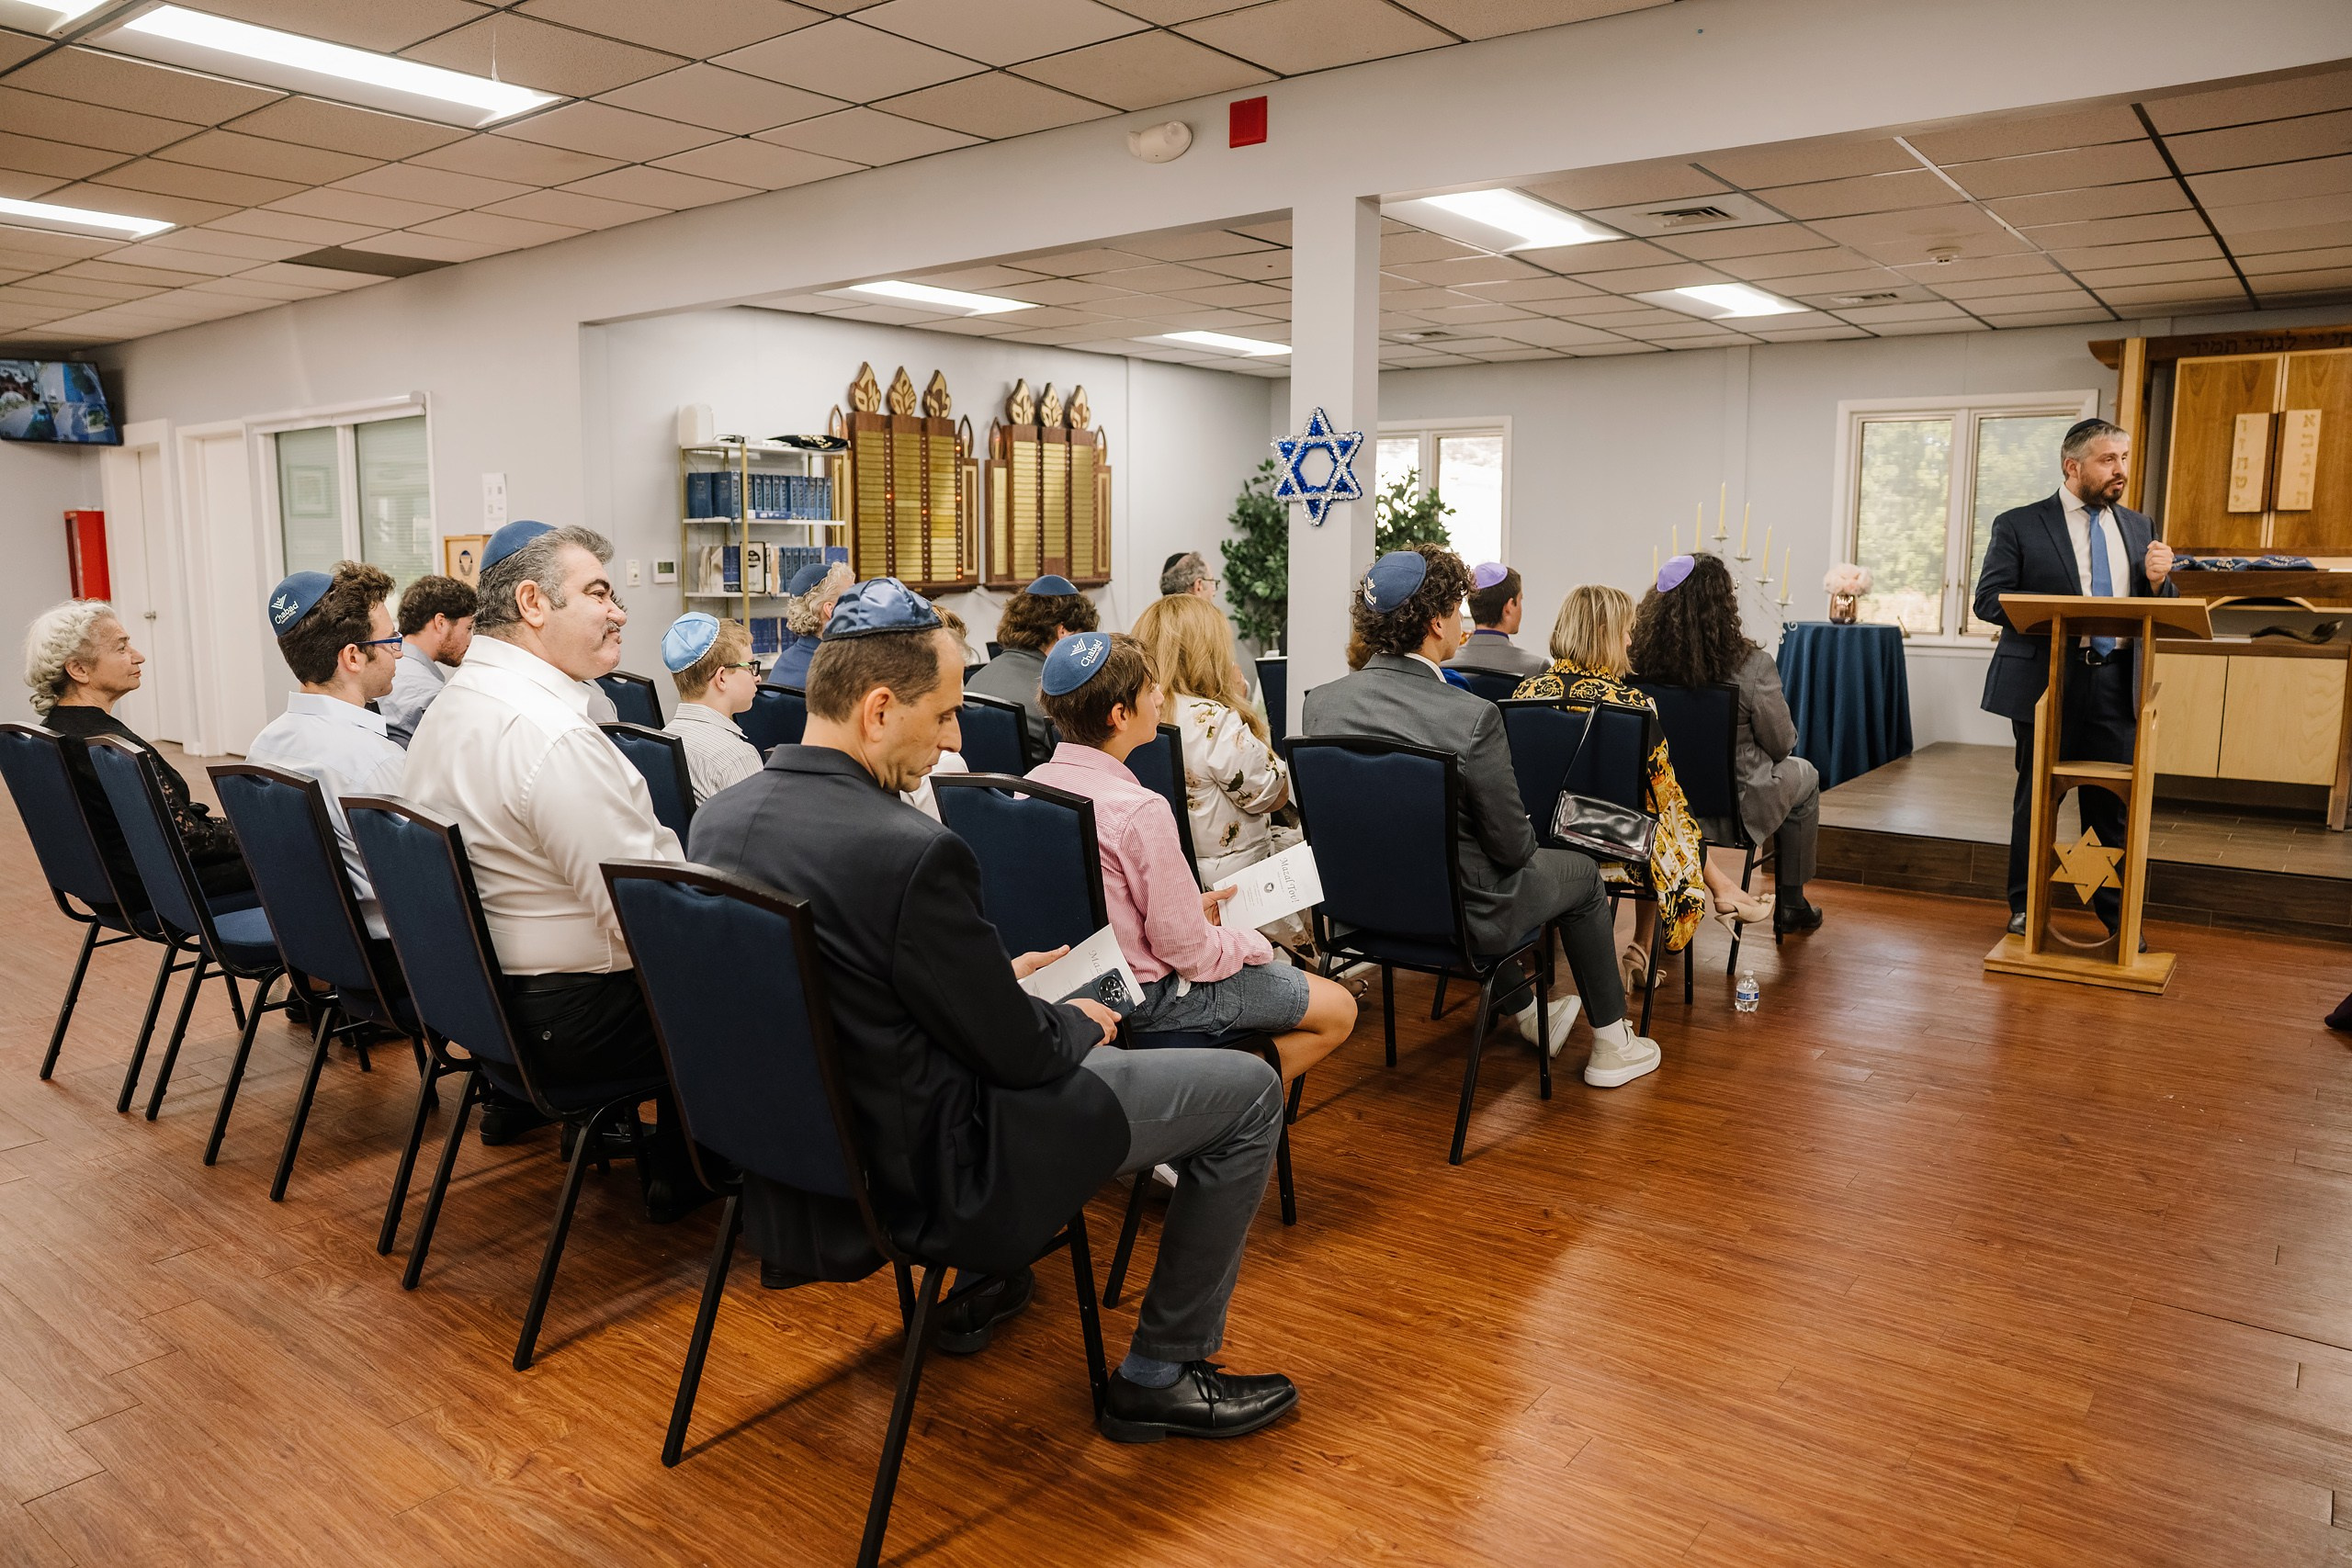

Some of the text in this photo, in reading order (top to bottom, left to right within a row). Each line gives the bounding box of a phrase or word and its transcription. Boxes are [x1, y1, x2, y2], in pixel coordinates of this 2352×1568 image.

[2245, 330, 2297, 351] לנגדי
[275, 600, 300, 625] Chabad
[1080, 638, 1103, 667] Chabad
[1280, 857, 1295, 883] Mazal
[1287, 883, 1300, 903] Tov!
[1089, 949, 1103, 975] Maz
